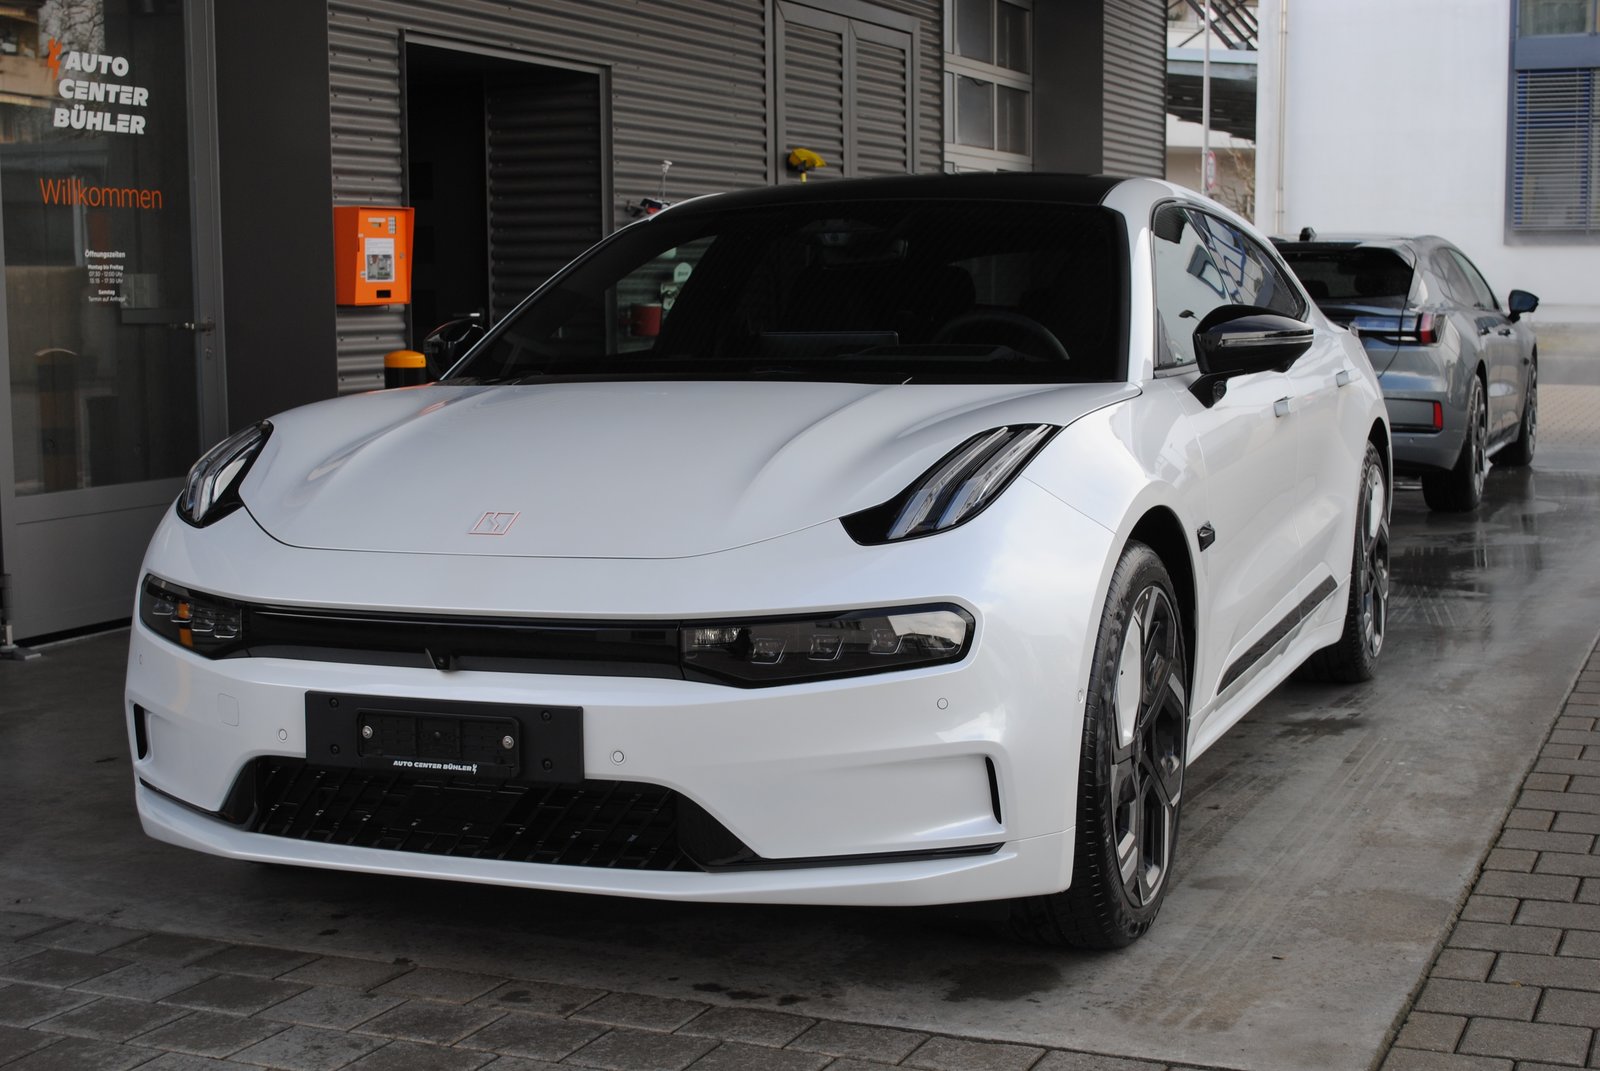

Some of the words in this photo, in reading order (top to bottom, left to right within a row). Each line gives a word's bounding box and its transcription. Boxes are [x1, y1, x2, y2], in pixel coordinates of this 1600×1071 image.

[65, 51, 129, 77] AUTO
[58, 79, 149, 107] CENTER
[54, 104, 147, 135] BÜHLER
[40, 177, 162, 210] Willkommen
[84, 249, 126, 259] Öffnungszeiten
[413, 761, 442, 770] CENTER
[442, 763, 472, 772] BÜHLER
